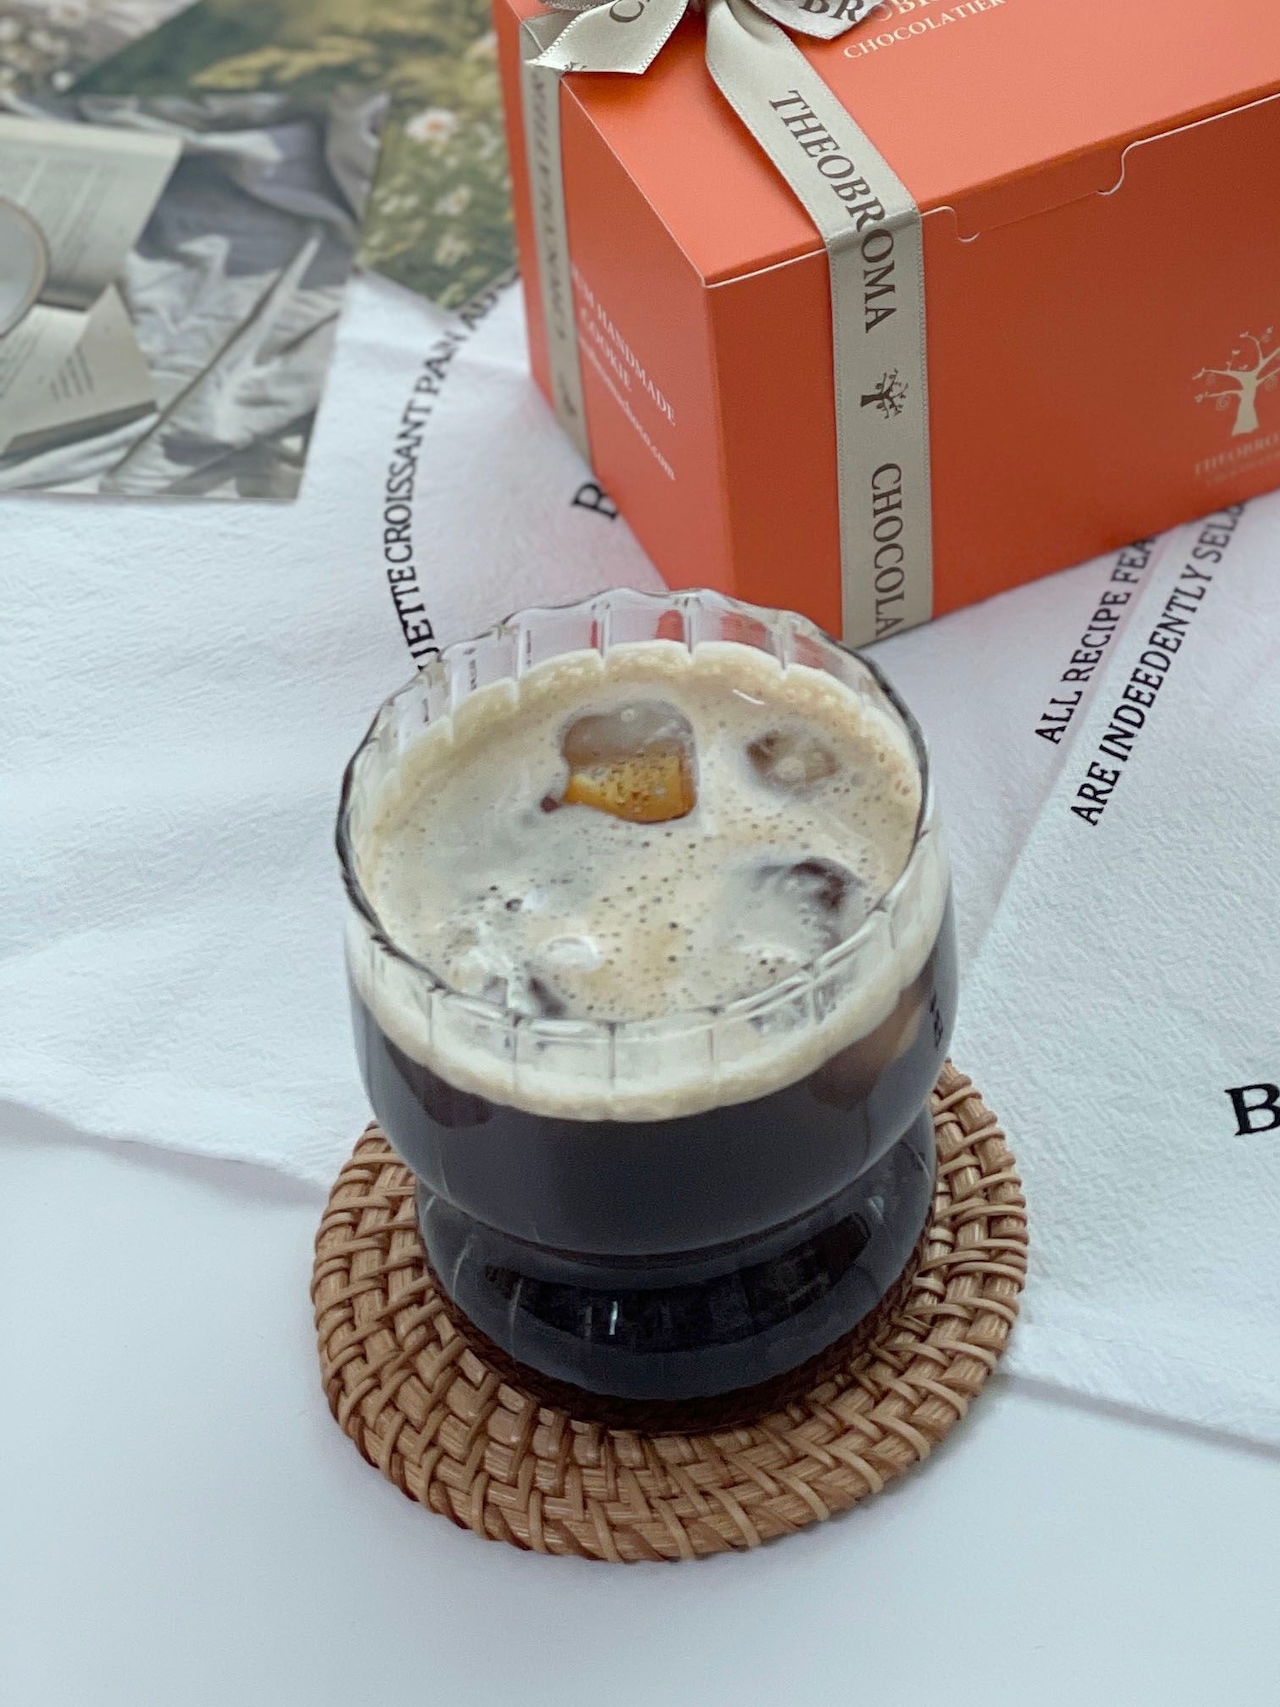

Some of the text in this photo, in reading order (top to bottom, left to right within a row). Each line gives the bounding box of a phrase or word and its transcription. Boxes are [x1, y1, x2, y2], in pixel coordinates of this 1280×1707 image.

[768, 90, 897, 334] THEOBROMA
[384, 399, 432, 564] CROISSANT
[1034, 690, 1083, 745] ALL
[1060, 591, 1132, 683] RECIPE
[1070, 761, 1121, 826] ARE
[1099, 562, 1214, 763] INDEEDENTLY
